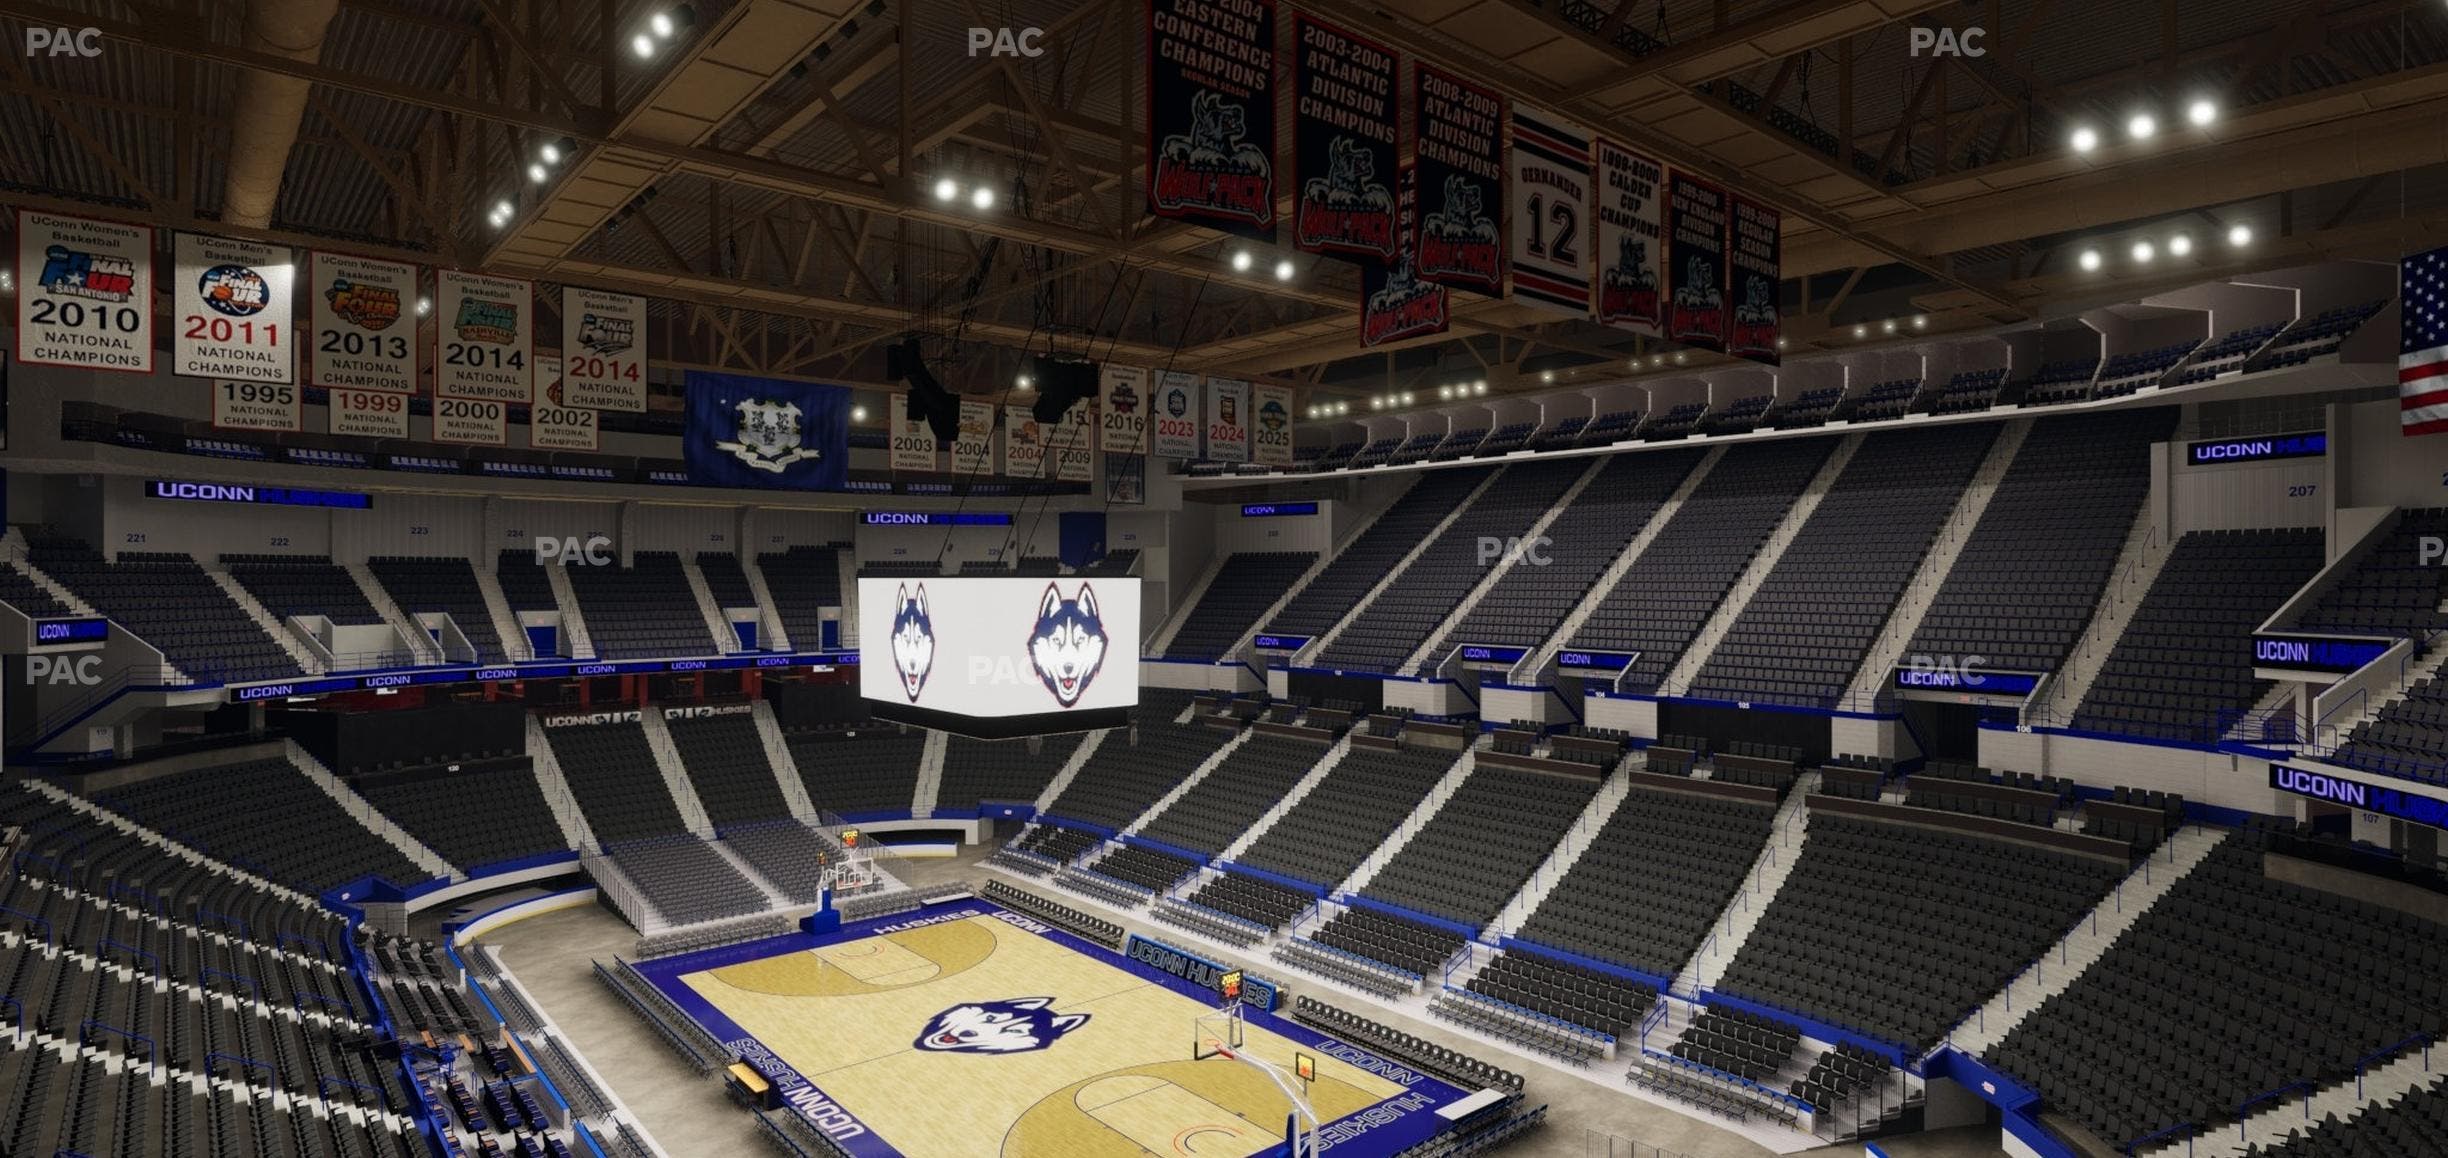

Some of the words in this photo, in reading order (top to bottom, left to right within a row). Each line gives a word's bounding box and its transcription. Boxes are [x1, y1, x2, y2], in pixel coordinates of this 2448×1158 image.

[1174, 0, 1257, 41] EASTERN
[1154, 11, 1271, 70] CONFERENCE
[1304, 25, 1391, 75] 2003-2004
[1160, 38, 1265, 90] CHAMPIONS
[1307, 51, 1389, 95] ATLANTIC
[1312, 76, 1384, 117] DIVISION
[1423, 74, 1498, 118] 2008-2009
[1300, 96, 1395, 143] CHAMPIONS
[1425, 96, 1494, 137] ATLANTIC
[1429, 119, 1491, 156] DIVISION
[1418, 137, 1500, 180] CHAMPIONS
[1602, 147, 1659, 184] 1999-2000
[1609, 170, 1652, 200] CALDER
[1621, 193, 1641, 213] CUP
[31, 215, 77, 231] UConn
[80, 222, 140, 239] Women's
[1527, 192, 1578, 268] 12
[1600, 206, 1660, 240] CHAMPIONS
[52, 231, 121, 248] Basketball
[196, 238, 236, 250] UConn
[240, 243, 272, 255] Men's
[205, 251, 265, 265] Basketball
[321, 256, 358, 269] UConn
[360, 261, 407, 274] Women's
[220, 274, 262, 291] FINAL
[338, 270, 392, 283] Basketball
[446, 273, 479, 285] UConn
[481, 277, 524, 290] Women's
[55, 282, 77, 295] SAN
[78, 286, 120, 301] ANTONIO
[462, 286, 510, 299] Basketball
[31, 299, 139, 333] 2010
[185, 315, 277, 347] 2011
[45, 332, 133, 350] NATIONAL
[320, 330, 408, 359] 2013
[35, 347, 141, 366] CHAMPIONS
[197, 346, 275, 363] NATIONAL
[446, 343, 524, 371] 2014
[188, 361, 282, 379] CHAMPIONS
[332, 359, 402, 374] NATIONAL
[569, 356, 640, 382] 2014
[324, 372, 408, 389] CHAMPIONS
[456, 371, 519, 385] NATIONAL
[224, 383, 293, 405] 1995
[449, 384, 525, 399] CHAMPIONS
[578, 382, 635, 396] NATIONAL
[230, 405, 288, 417] NATIONAL
[339, 392, 401, 413] 1999
[440, 400, 499, 420] 2000
[572, 395, 641, 410] CHAMPIONS
[224, 416, 294, 428] CHAMPIONS
[345, 413, 398, 424] NATIONAL
[447, 421, 495, 431] NATIONAL
[538, 408, 592, 427] 2002
[1105, 413, 1144, 431] 2016
[339, 424, 402, 435] CHAMPIONS
[442, 431, 499, 441] CHAMPIONS
[544, 427, 588, 438] NATIONAL
[1159, 420, 1194, 437] 2023
[1210, 424, 1245, 443] 2024
[538, 437, 593, 448] CHAMPIONS
[895, 437, 932, 452] 2003
[1257, 430, 1289, 446] 2025
[2196, 441, 2272, 460] UCONN
[158, 482, 254, 501] UCONN
[2288, 485, 2317, 497] 207
[867, 513, 928, 524] UCONN
[1244, 506, 1275, 515] UCONN
[127, 533, 146, 543] 221
[270, 538, 289, 547] 222
[39, 623, 71, 639] UCONN
[1257, 637, 1279, 646] UCONN
[1464, 648, 1490, 659] UCONN
[1560, 653, 1591, 665] UCONN
[2256, 640, 2309, 662] UCONN
[577, 664, 616, 675] UCONN
[671, 661, 707, 671] UCONN
[757, 657, 790, 666] UCONN
[366, 676, 411, 687] UCONN
[476, 669, 518, 680] UCONN
[1900, 672, 1955, 686] UCONN
[240, 685, 293, 700] UCONN
[546, 716, 594, 727] UCONN
[2277, 768, 2365, 806] UCONN
[2363, 813, 2379, 824] 107
[874, 909, 980, 935] HUSKIES
[992, 910, 1053, 934] UCONN
[1129, 938, 1187, 975] UCONN
[1315, 1040, 1424, 1086] UCONN
[784, 1078, 865, 1140] UCONN
